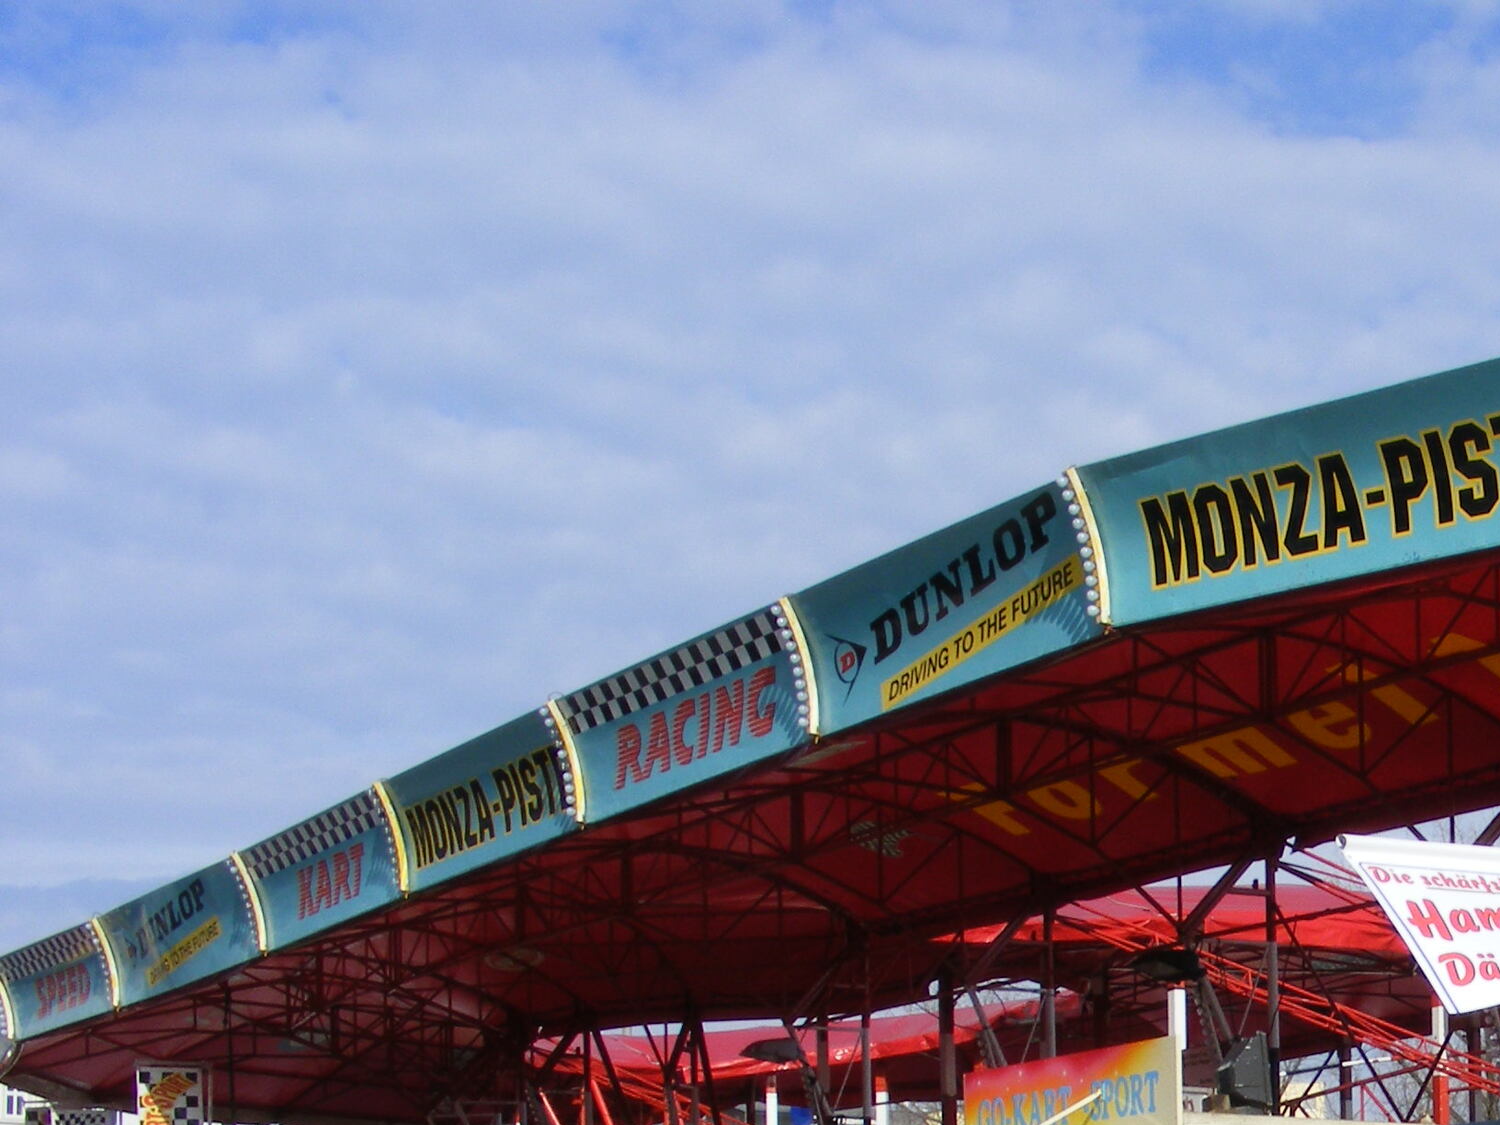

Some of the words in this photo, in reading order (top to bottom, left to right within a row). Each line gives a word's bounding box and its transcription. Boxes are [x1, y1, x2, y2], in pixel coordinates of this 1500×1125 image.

[870, 492, 1057, 665] DUNLOP
[889, 645, 949, 701] DRIVING
[953, 630, 974, 656] TO
[979, 613, 1008, 643] THE
[1012, 562, 1075, 622] FUTURE
[614, 665, 777, 790] RACING
[295, 842, 364, 920] KART
[1368, 866, 1411, 885] Die
[134, 878, 205, 960] DUNLOP
[33, 963, 92, 1020] SPEED
